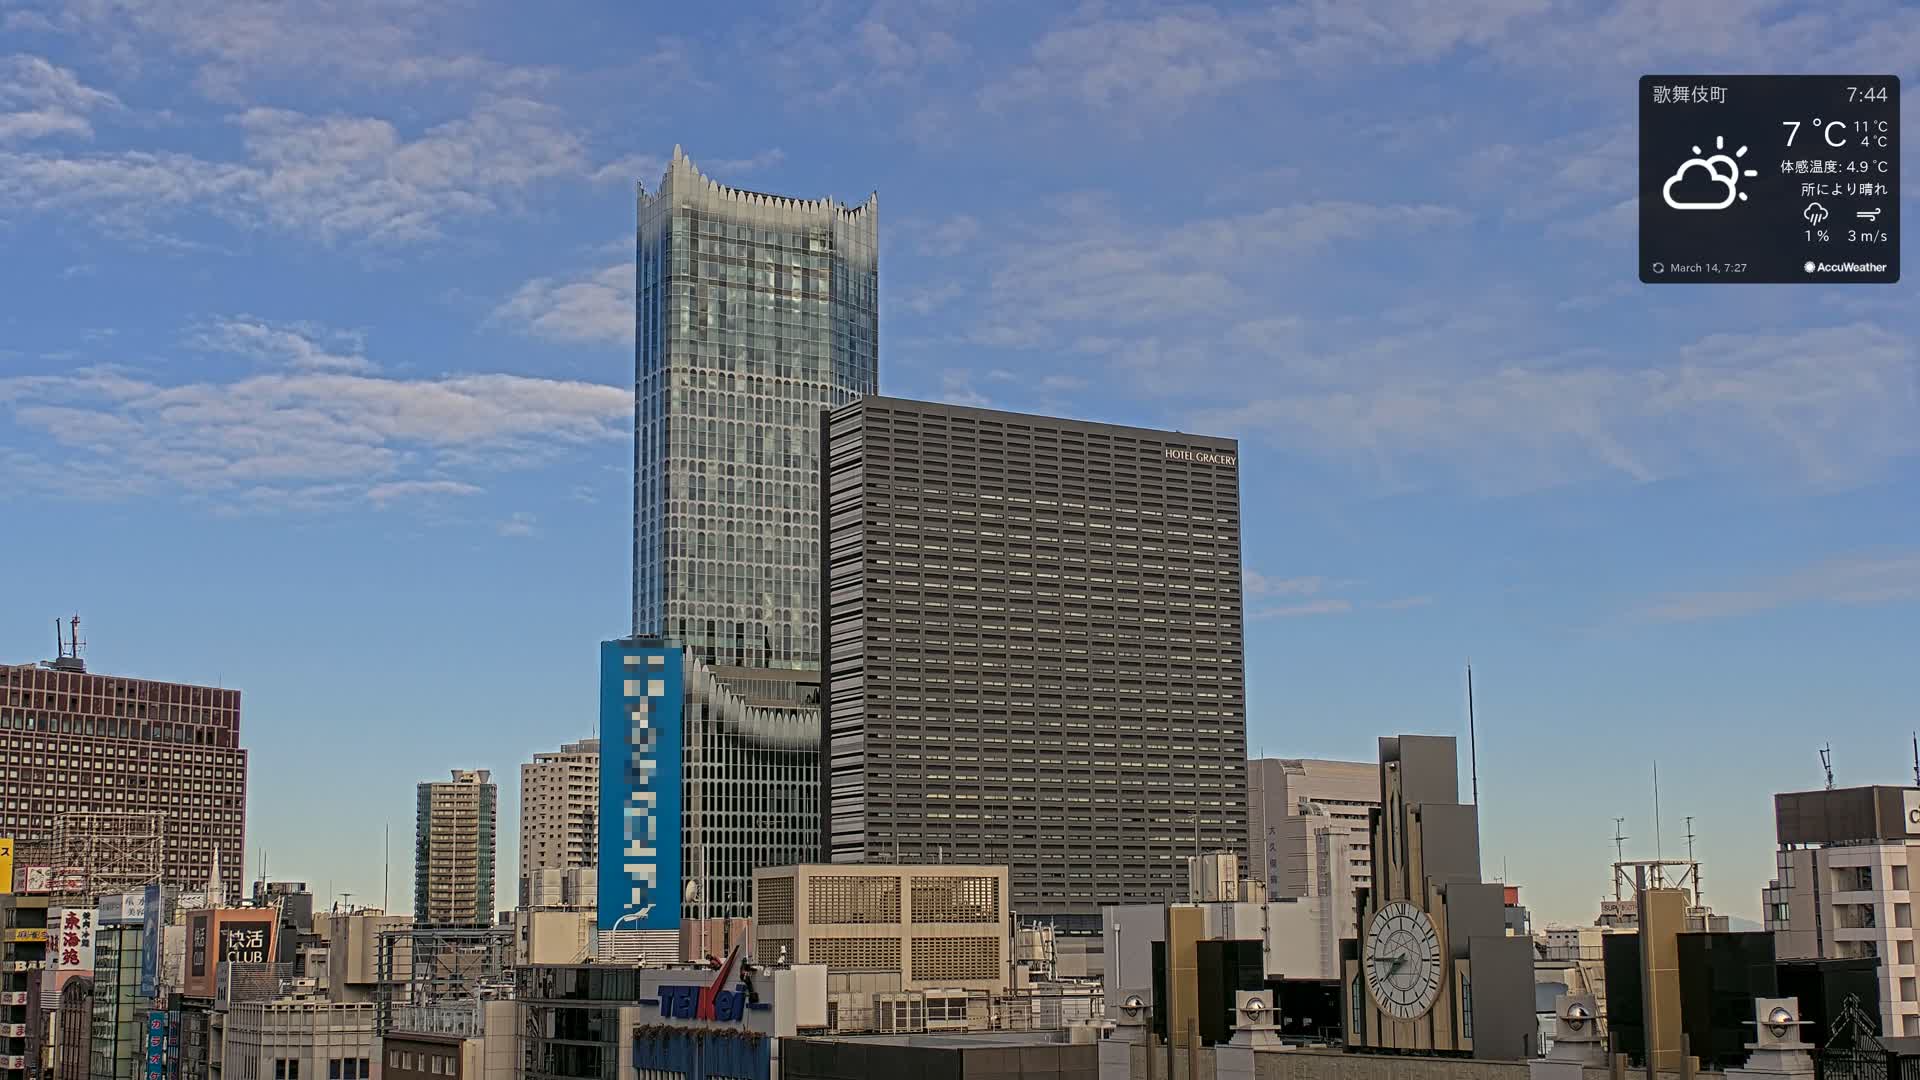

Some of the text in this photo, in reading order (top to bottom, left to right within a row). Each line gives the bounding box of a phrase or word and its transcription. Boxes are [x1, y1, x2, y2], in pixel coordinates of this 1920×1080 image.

[1165, 449, 1237, 466] HOTEL GRACERY
[227, 929, 264, 948] 快活
[227, 951, 263, 963] CLUB
